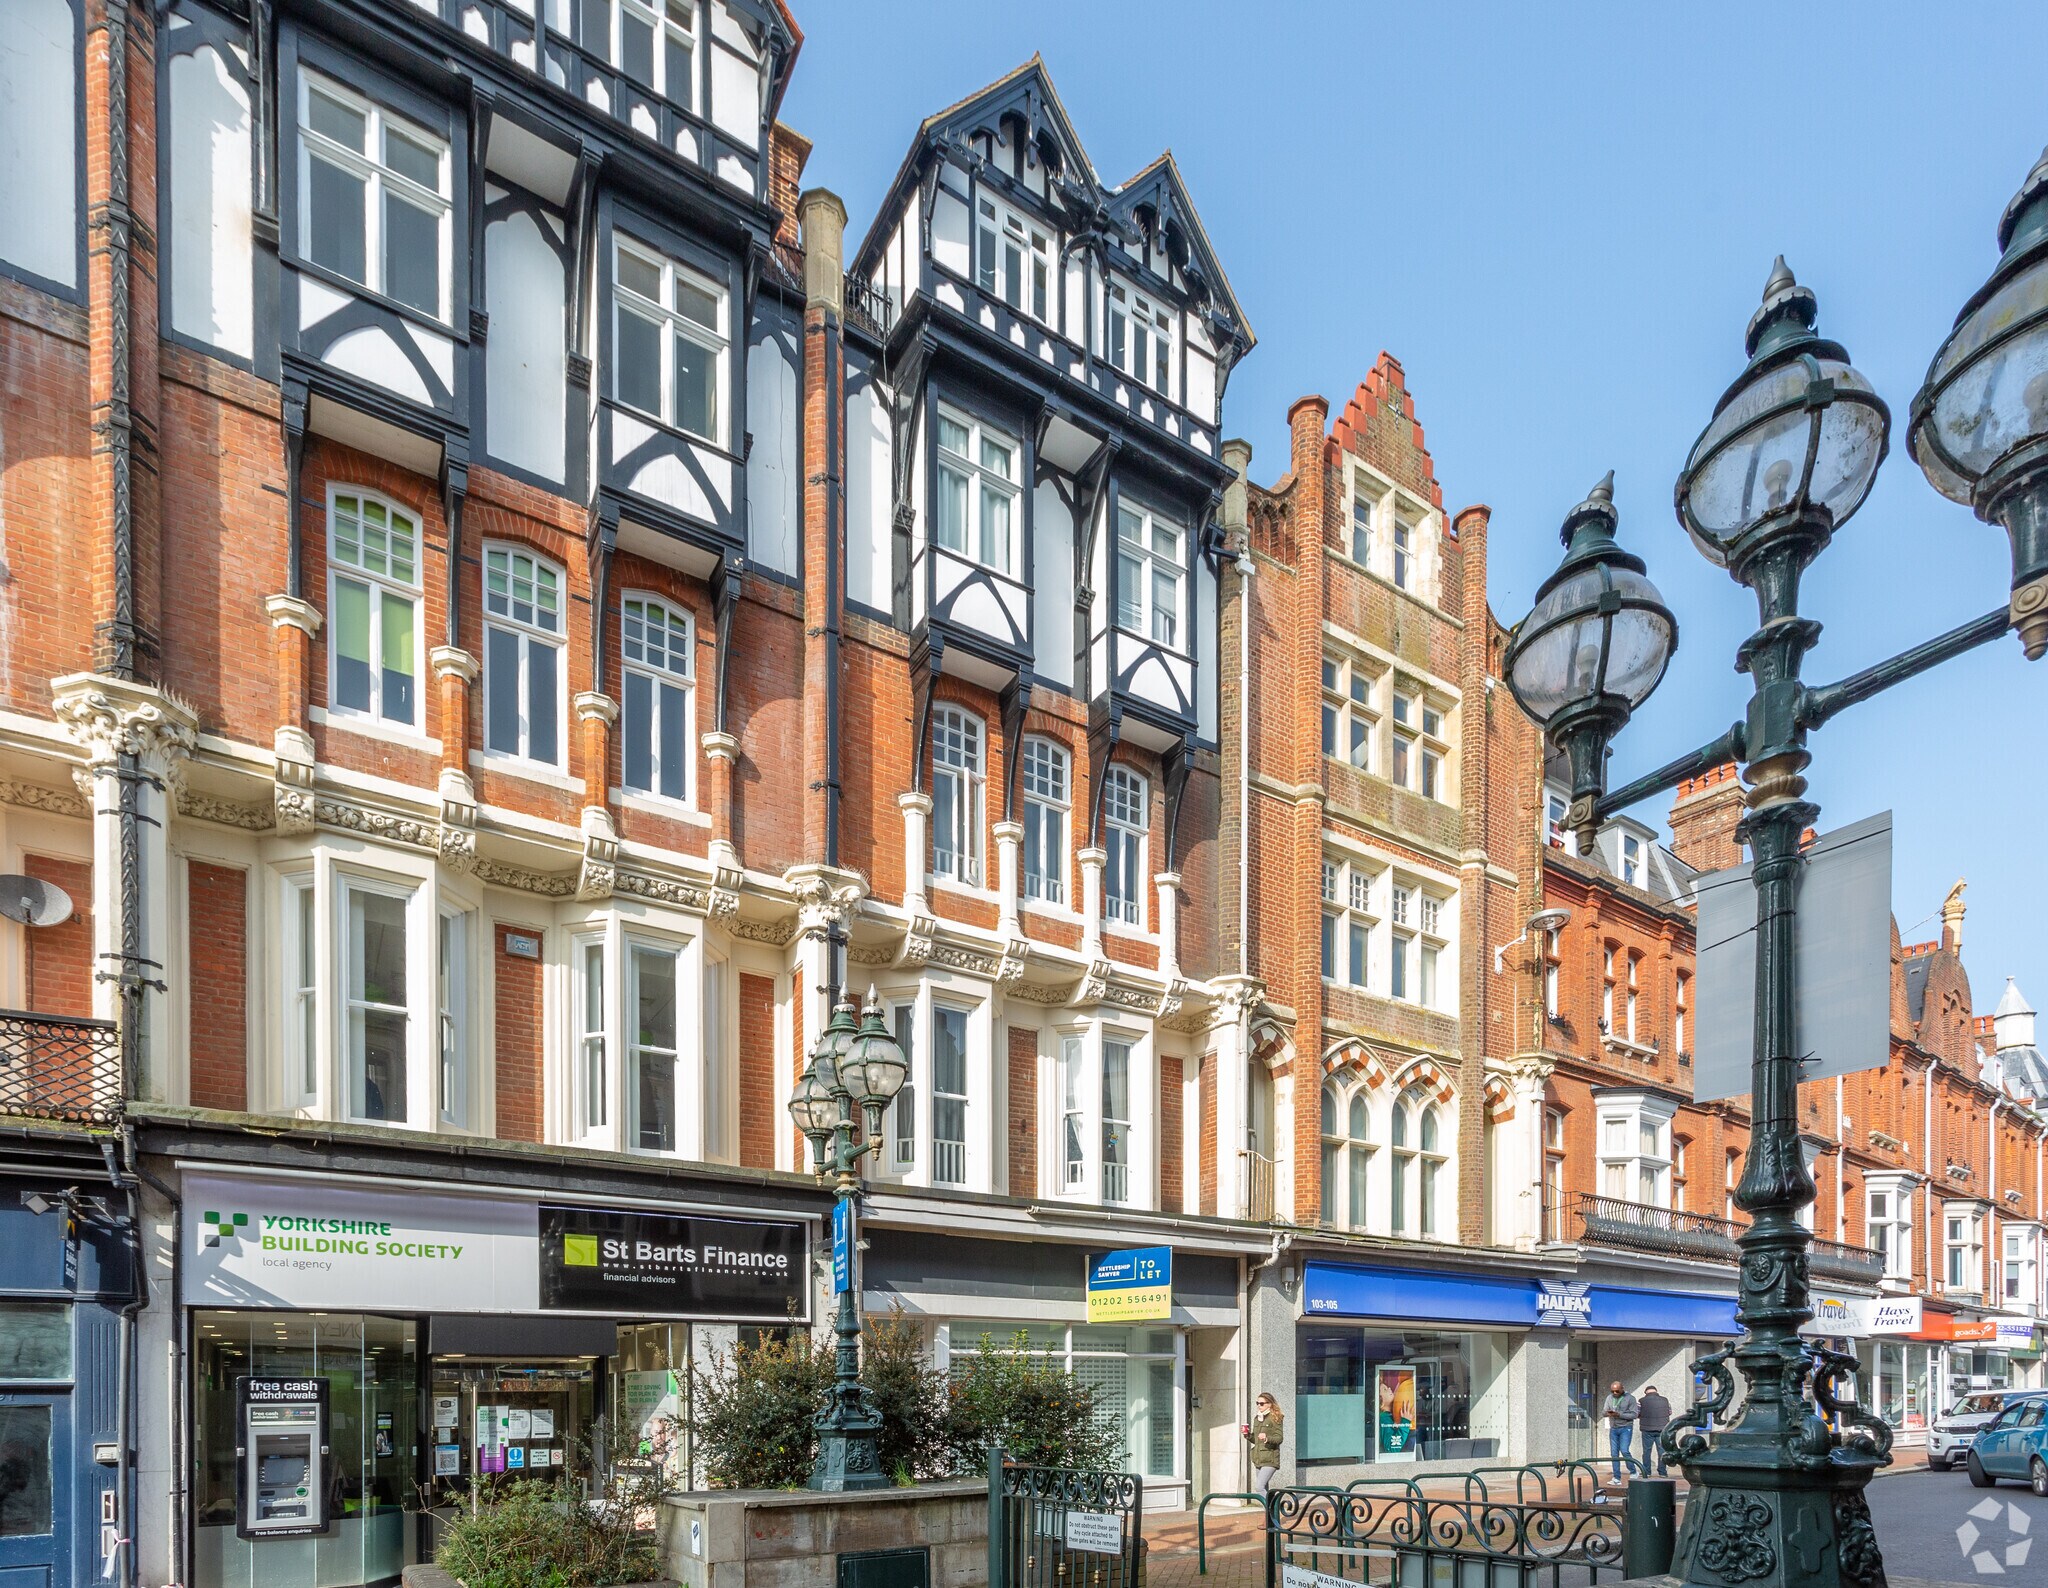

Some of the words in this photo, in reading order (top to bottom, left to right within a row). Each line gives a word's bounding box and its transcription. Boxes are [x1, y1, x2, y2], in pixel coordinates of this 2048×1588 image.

[262, 1215, 392, 1236] YORKSHIRE
[262, 1235, 369, 1255] BUILDING
[375, 1241, 464, 1259] SOCIETY
[602, 1239, 629, 1259] St
[635, 1241, 696, 1263] Barts
[703, 1245, 788, 1268] Finance
[262, 1257, 290, 1267] local
[292, 1259, 332, 1271] agency
[602, 1263, 789, 1277] www.stbartsfinance.co.uk
[1097, 1264, 1131, 1272] NETTLESHIP
[1140, 1259, 1155, 1269] TO
[603, 1272, 639, 1282] financial
[641, 1274, 676, 1284] advisors
[1140, 1270, 1161, 1279] LET
[1091, 1296, 1122, 1306] 01202
[1127, 1294, 1167, 1303] 556491
[1311, 1299, 1338, 1310] 103-105
[1538, 1294, 1591, 1312] HALIFAX
[1817, 1298, 1847, 1320] Travel
[1879, 1306, 1911, 1318] Hays
[1873, 1316, 1914, 1326] Travel
[1996, 1324, 2032, 1332] 02-551821
[249, 1380, 280, 1391] free
[283, 1380, 318, 1391] cash
[249, 1391, 317, 1400] withdrawals
[1286, 1576, 1296, 1585] Do
